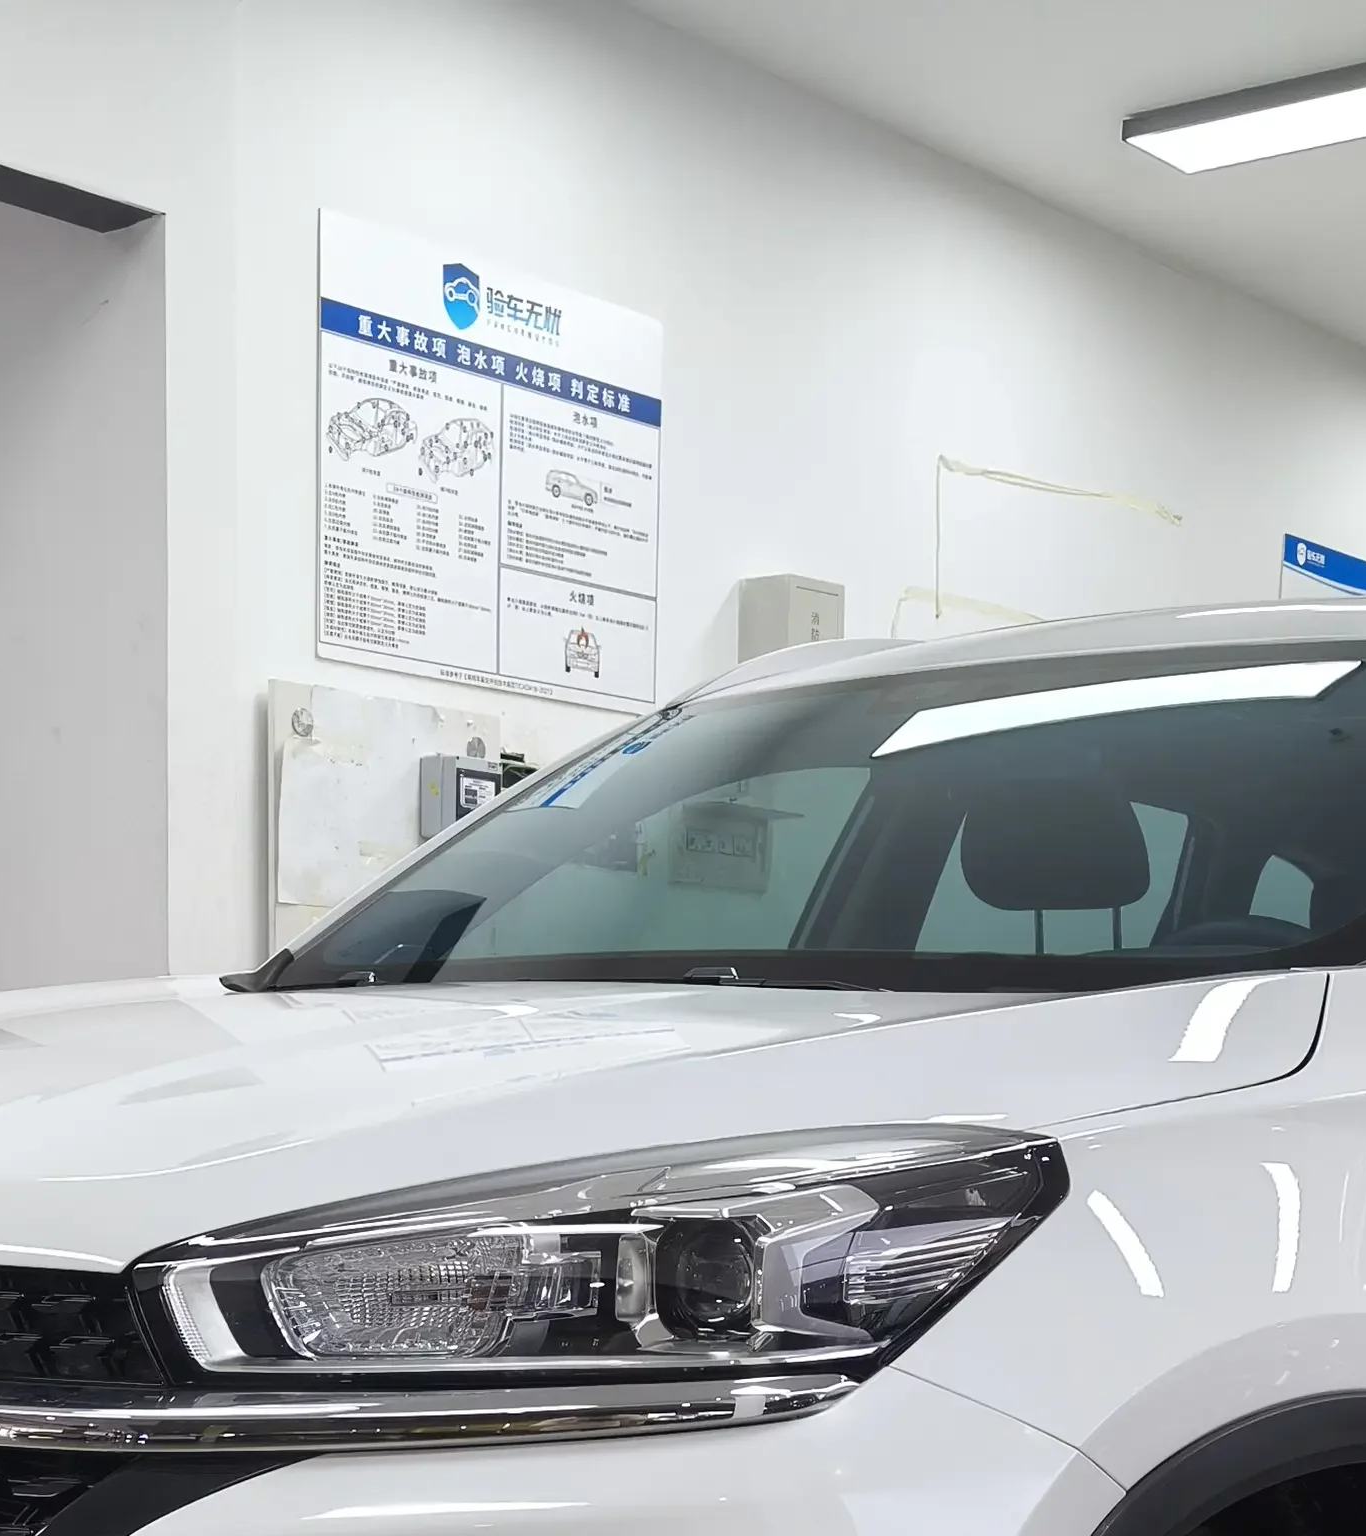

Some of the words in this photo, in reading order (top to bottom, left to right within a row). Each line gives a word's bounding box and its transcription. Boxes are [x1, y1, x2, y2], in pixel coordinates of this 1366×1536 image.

[487, 287, 562, 336] 验车无忧
[358, 314, 447, 359] 重大事故项
[457, 344, 506, 376] 泡水项
[515, 362, 562, 393] 火烧项
[570, 378, 631, 413] 判定标准
